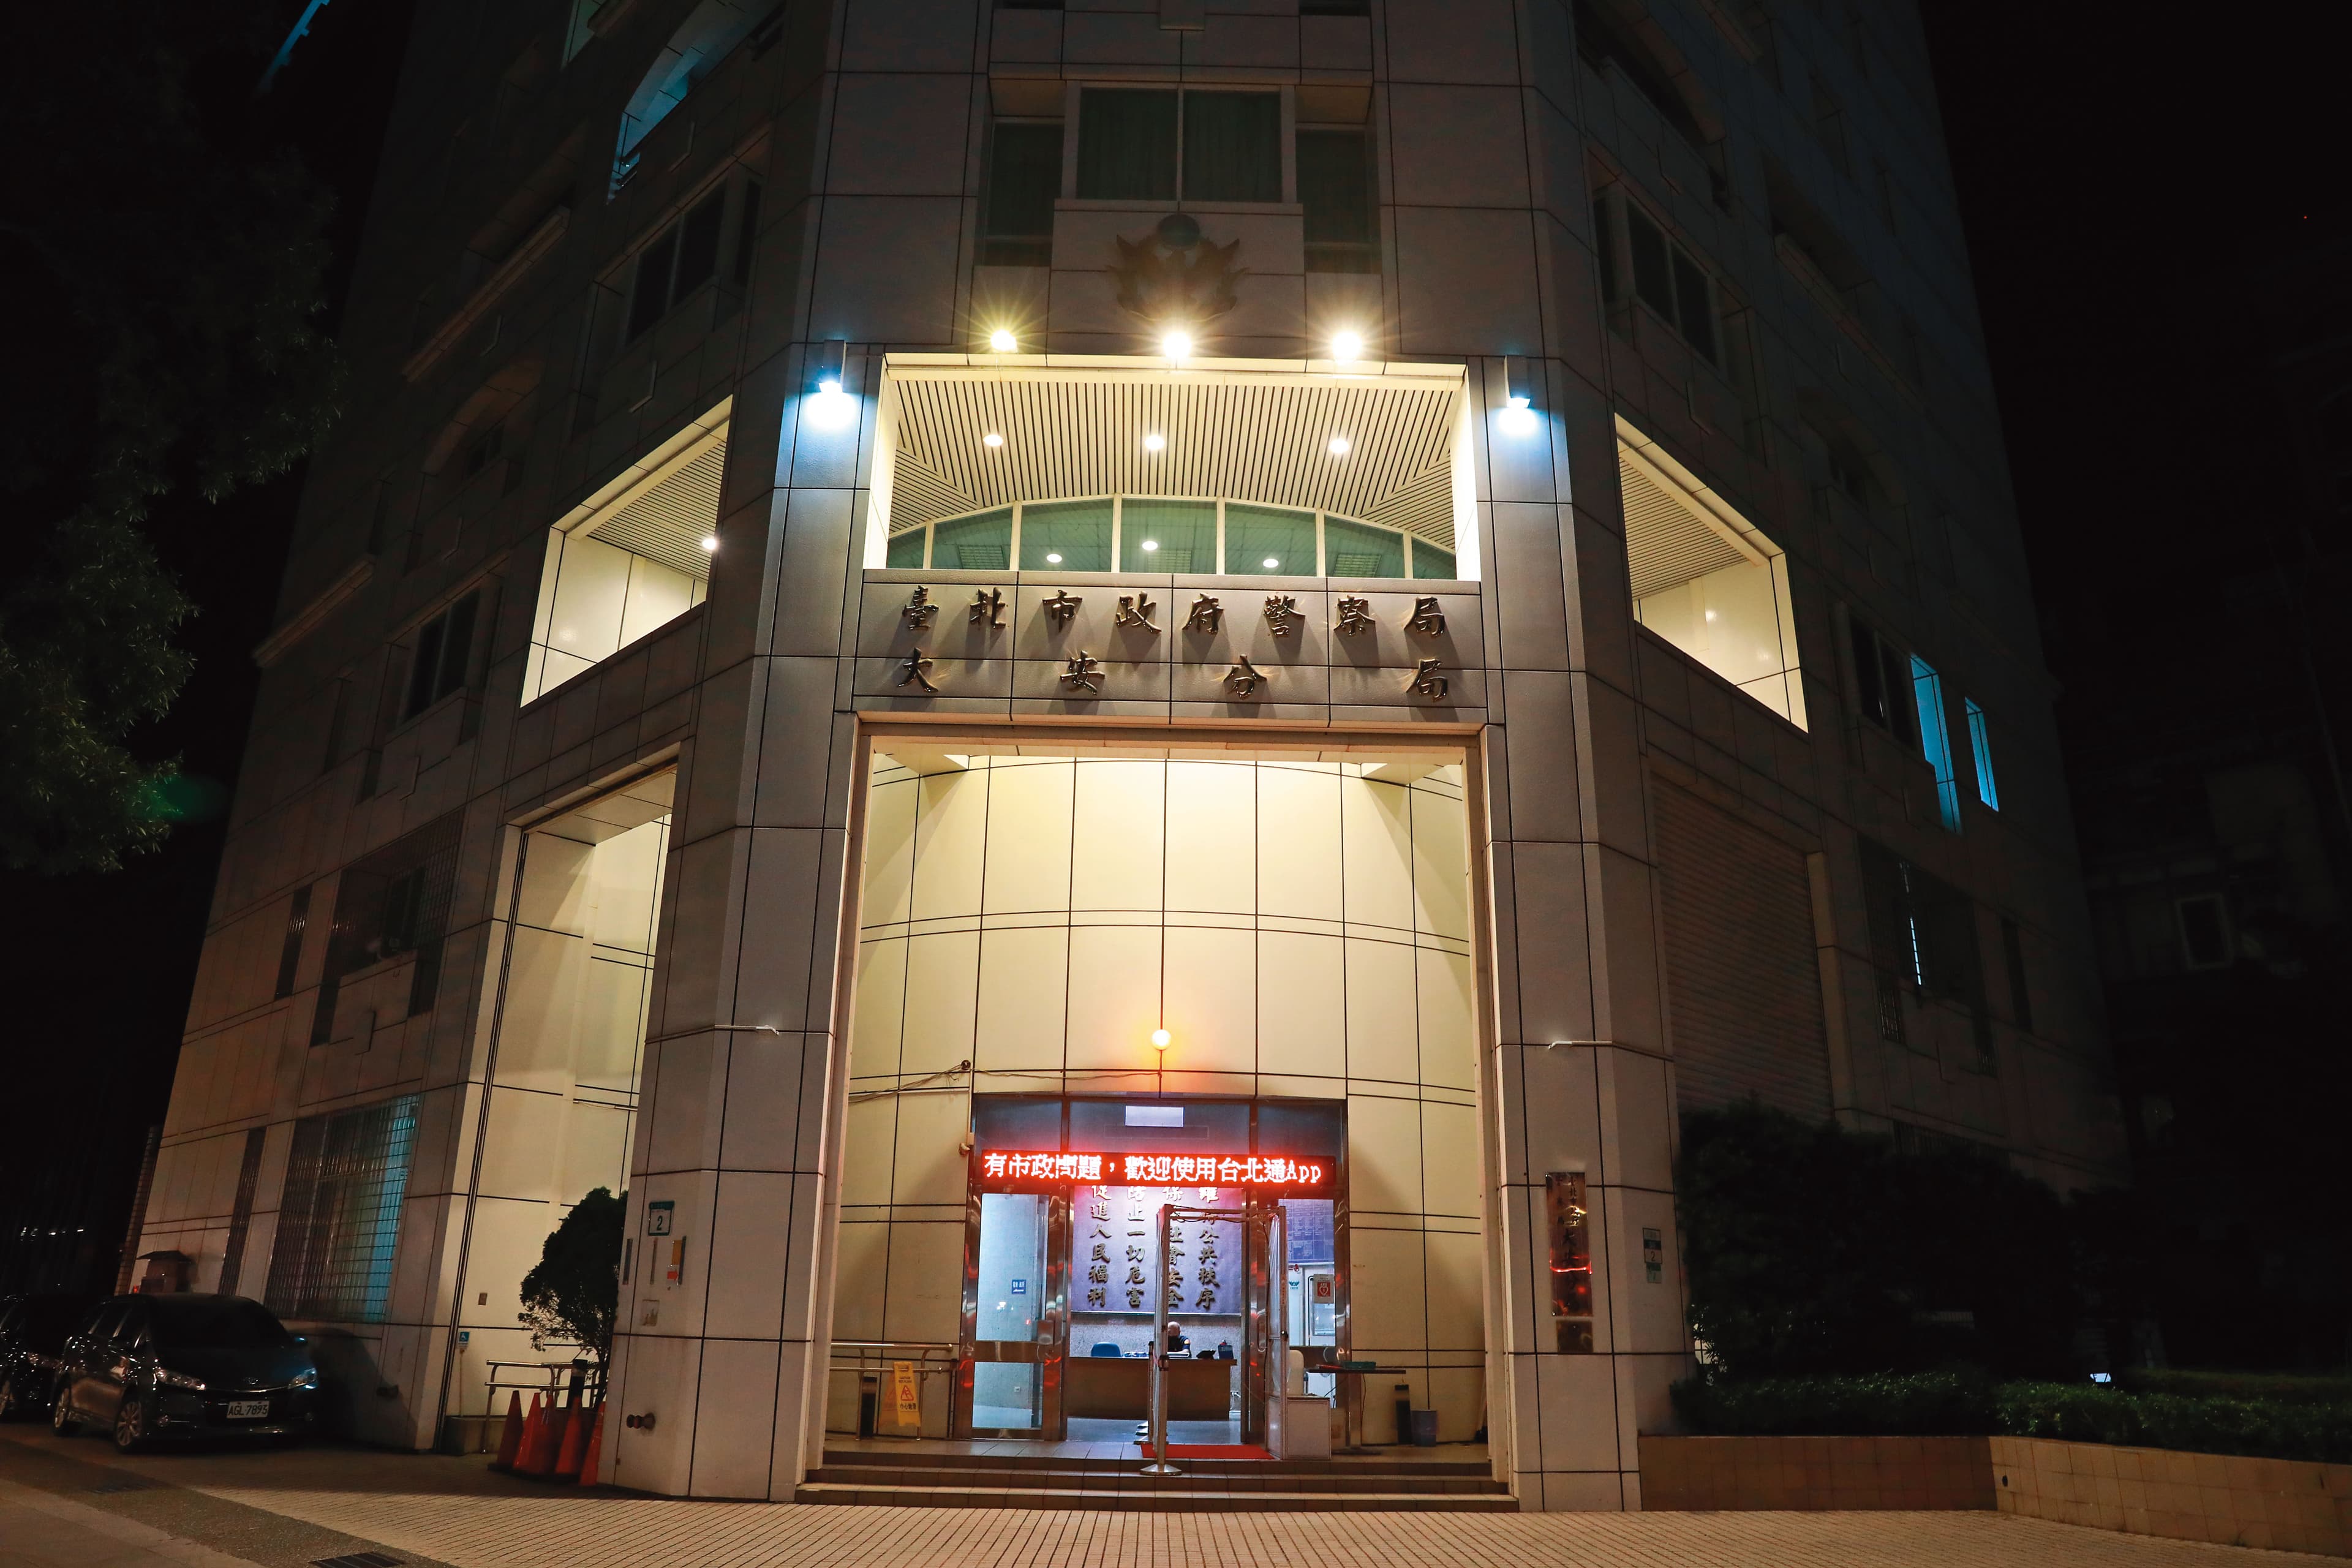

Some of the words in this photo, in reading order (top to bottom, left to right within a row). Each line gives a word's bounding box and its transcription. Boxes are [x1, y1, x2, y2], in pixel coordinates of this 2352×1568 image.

[902, 585, 1446, 637] 臺北市政府警察局
[897, 647, 1448, 701] 大安分局
[657, 1215, 663, 1231] 2
[1163, 1186, 1185, 1308] 保社會安全
[1651, 1251, 1656, 1262] 2
